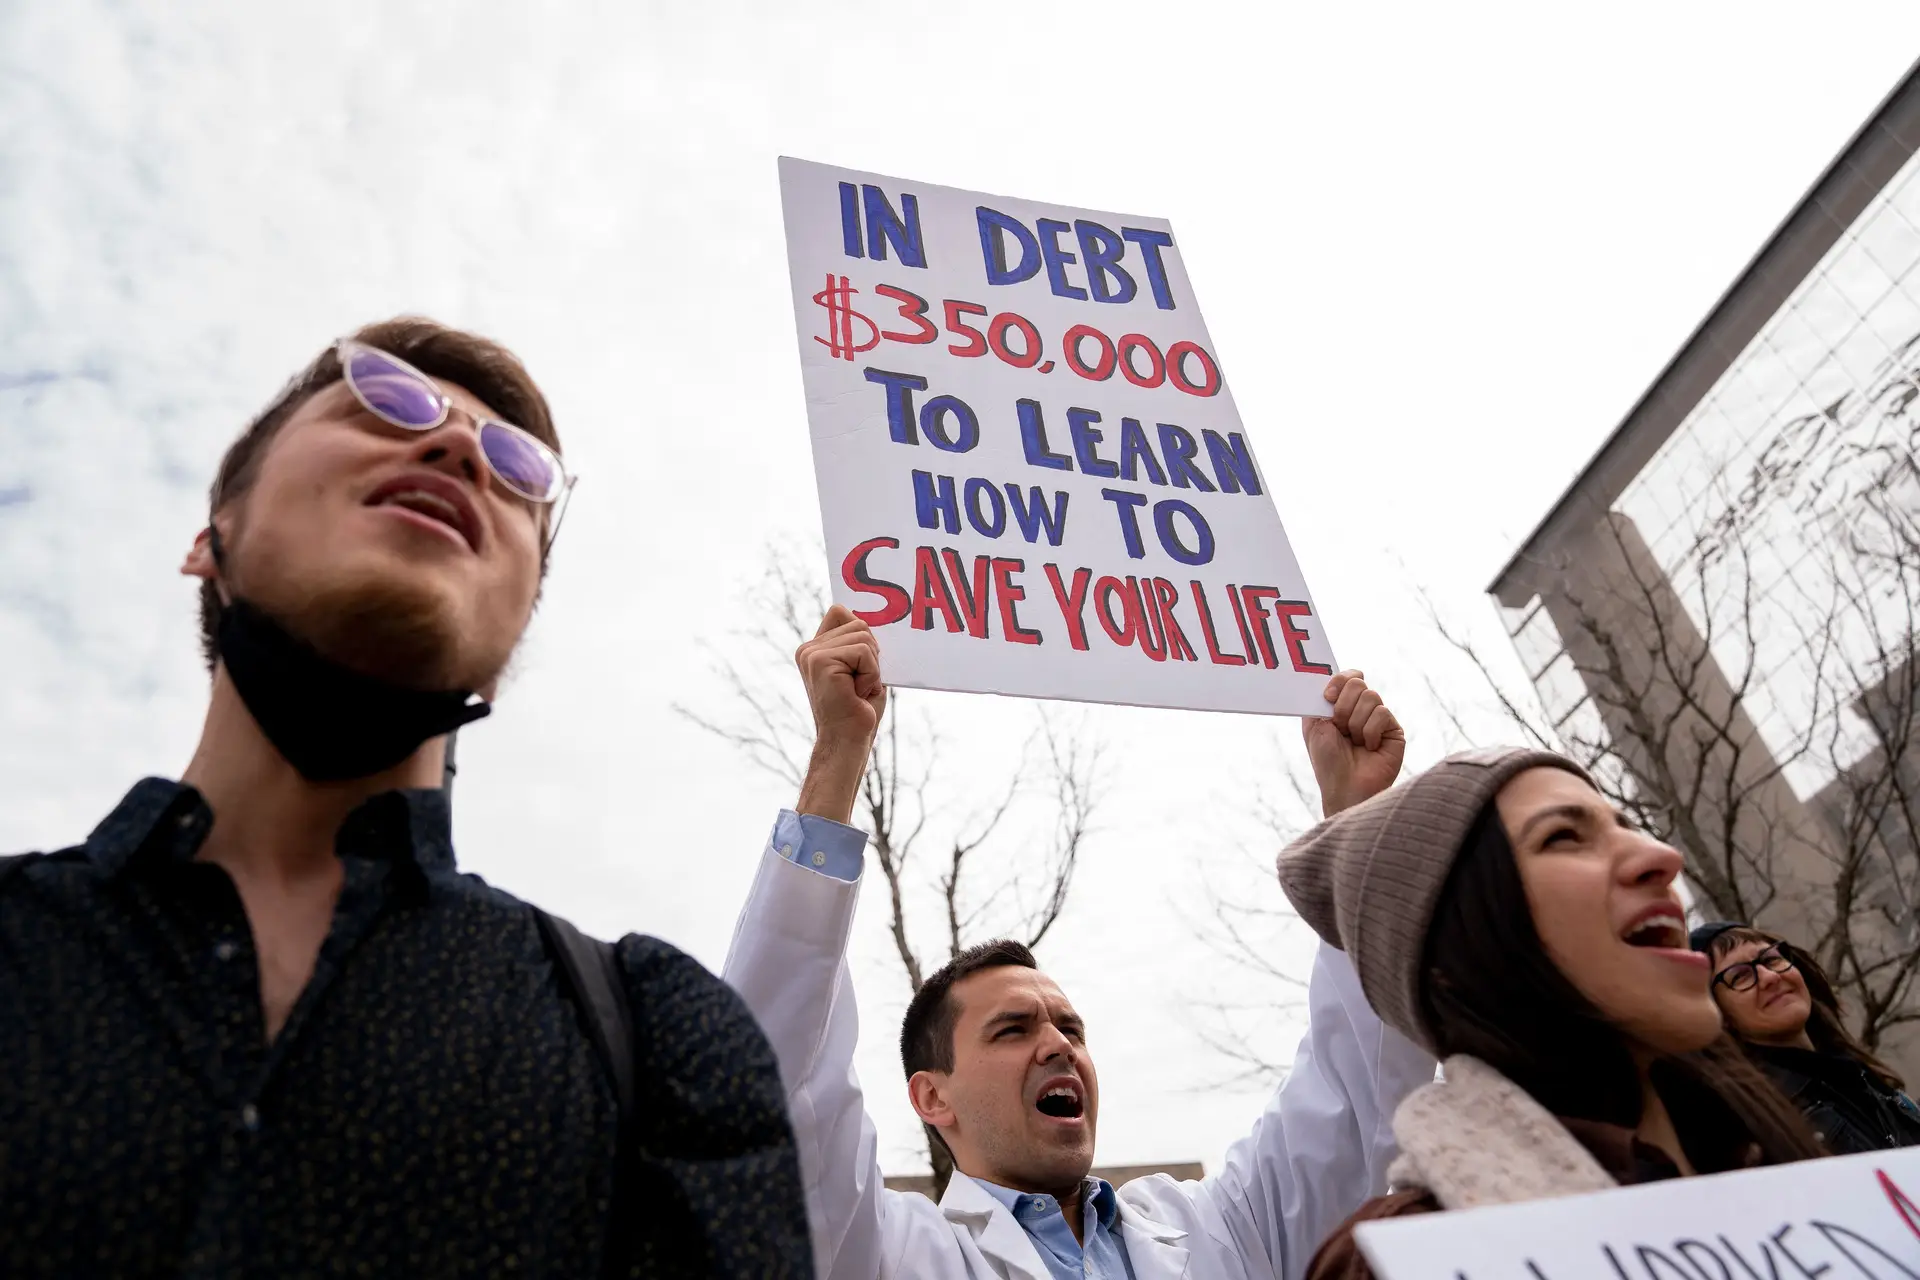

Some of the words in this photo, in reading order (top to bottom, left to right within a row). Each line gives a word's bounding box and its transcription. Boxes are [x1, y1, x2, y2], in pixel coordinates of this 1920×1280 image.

[839, 182, 928, 268] IN
[976, 206, 1176, 310] DEBT
[813, 274, 1222, 398] $350,000
[863, 367, 980, 453] TO
[1016, 398, 1264, 496] LEARN
[912, 469, 1070, 546] HOW
[1101, 488, 1216, 566] TO
[841, 537, 1043, 646] SAVE
[1043, 563, 1198, 662] YOUR
[1190, 580, 1333, 676] LIFE
